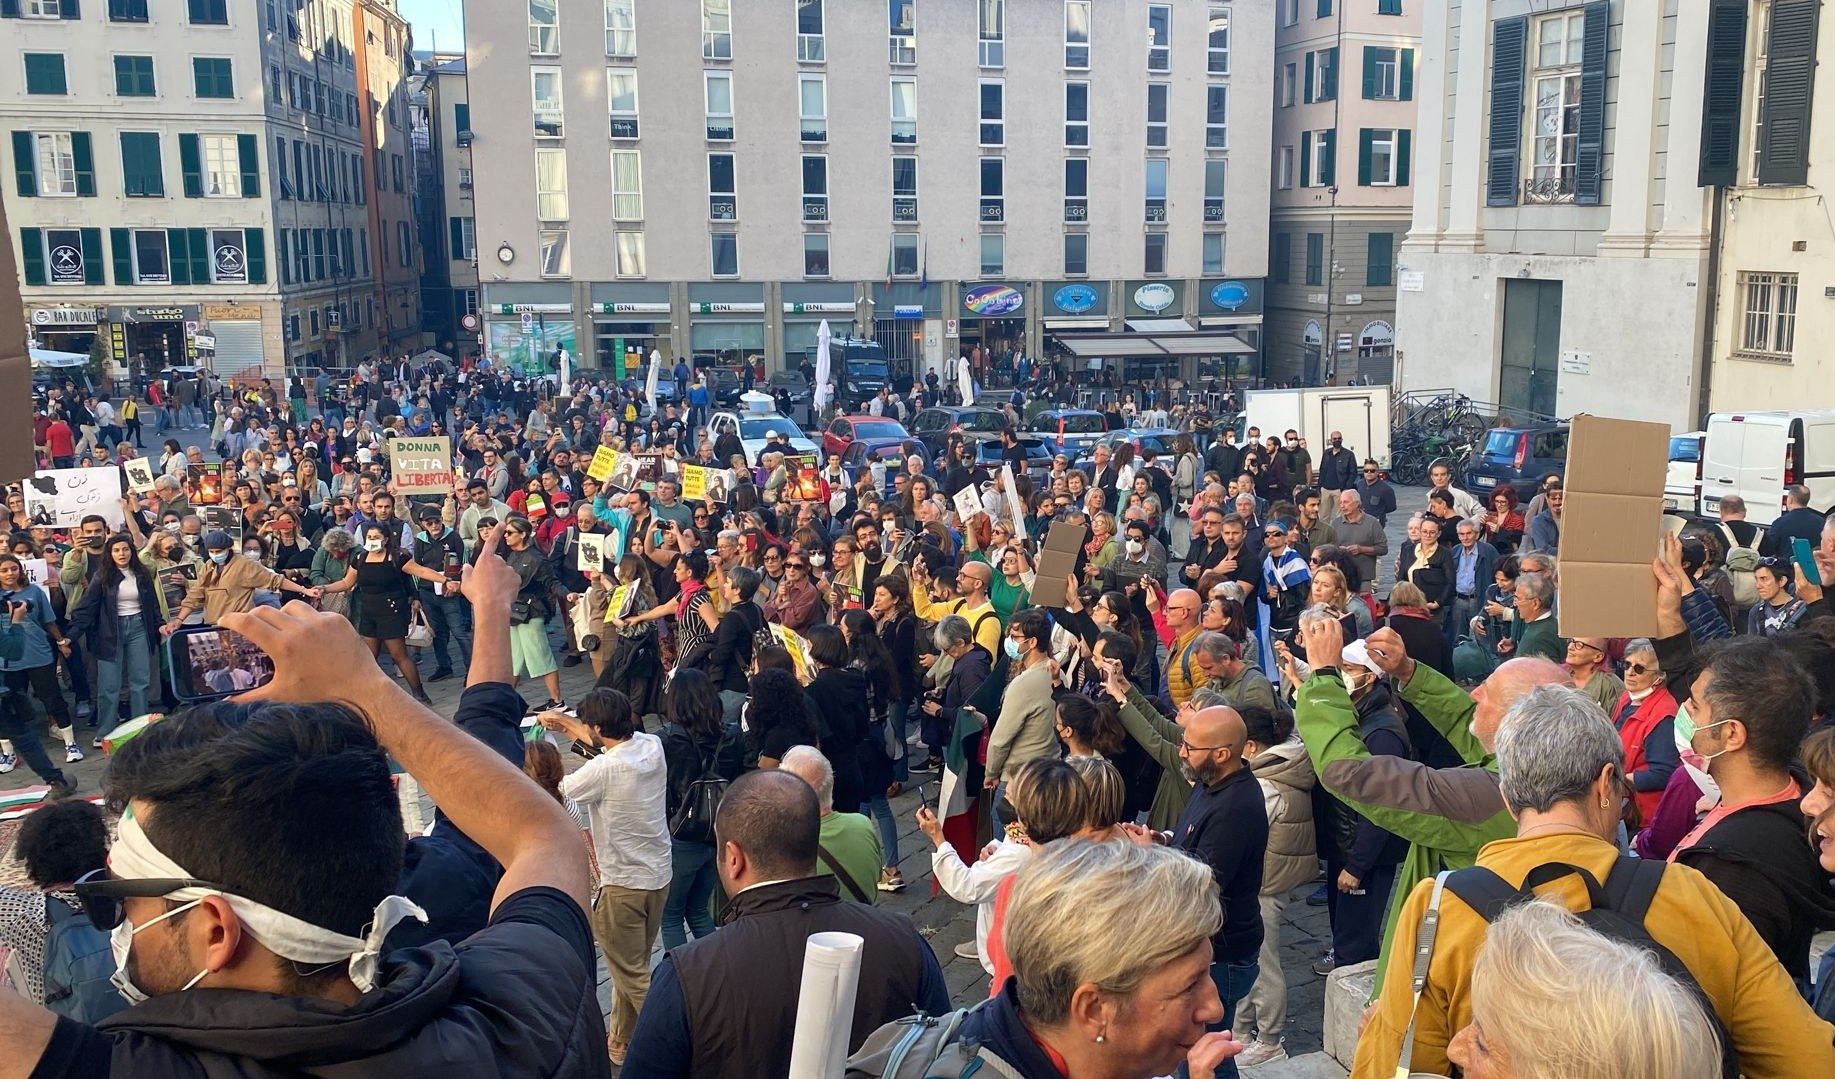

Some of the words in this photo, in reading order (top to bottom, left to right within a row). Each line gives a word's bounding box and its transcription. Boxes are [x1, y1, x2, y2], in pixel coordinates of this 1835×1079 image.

[136, 307, 183, 315] studio
[53, 311, 68, 322] BAR
[70, 311, 97, 323] DUCALE
[1363, 320, 1392, 334] IMMOBILIARE
[396, 442, 441, 452] DONNA
[598, 448, 615, 459] SIAMO
[397, 458, 443, 471] VITA
[595, 454, 610, 465] TUTTE
[686, 468, 703, 476] SIAMO
[67, 474, 88, 488] زن
